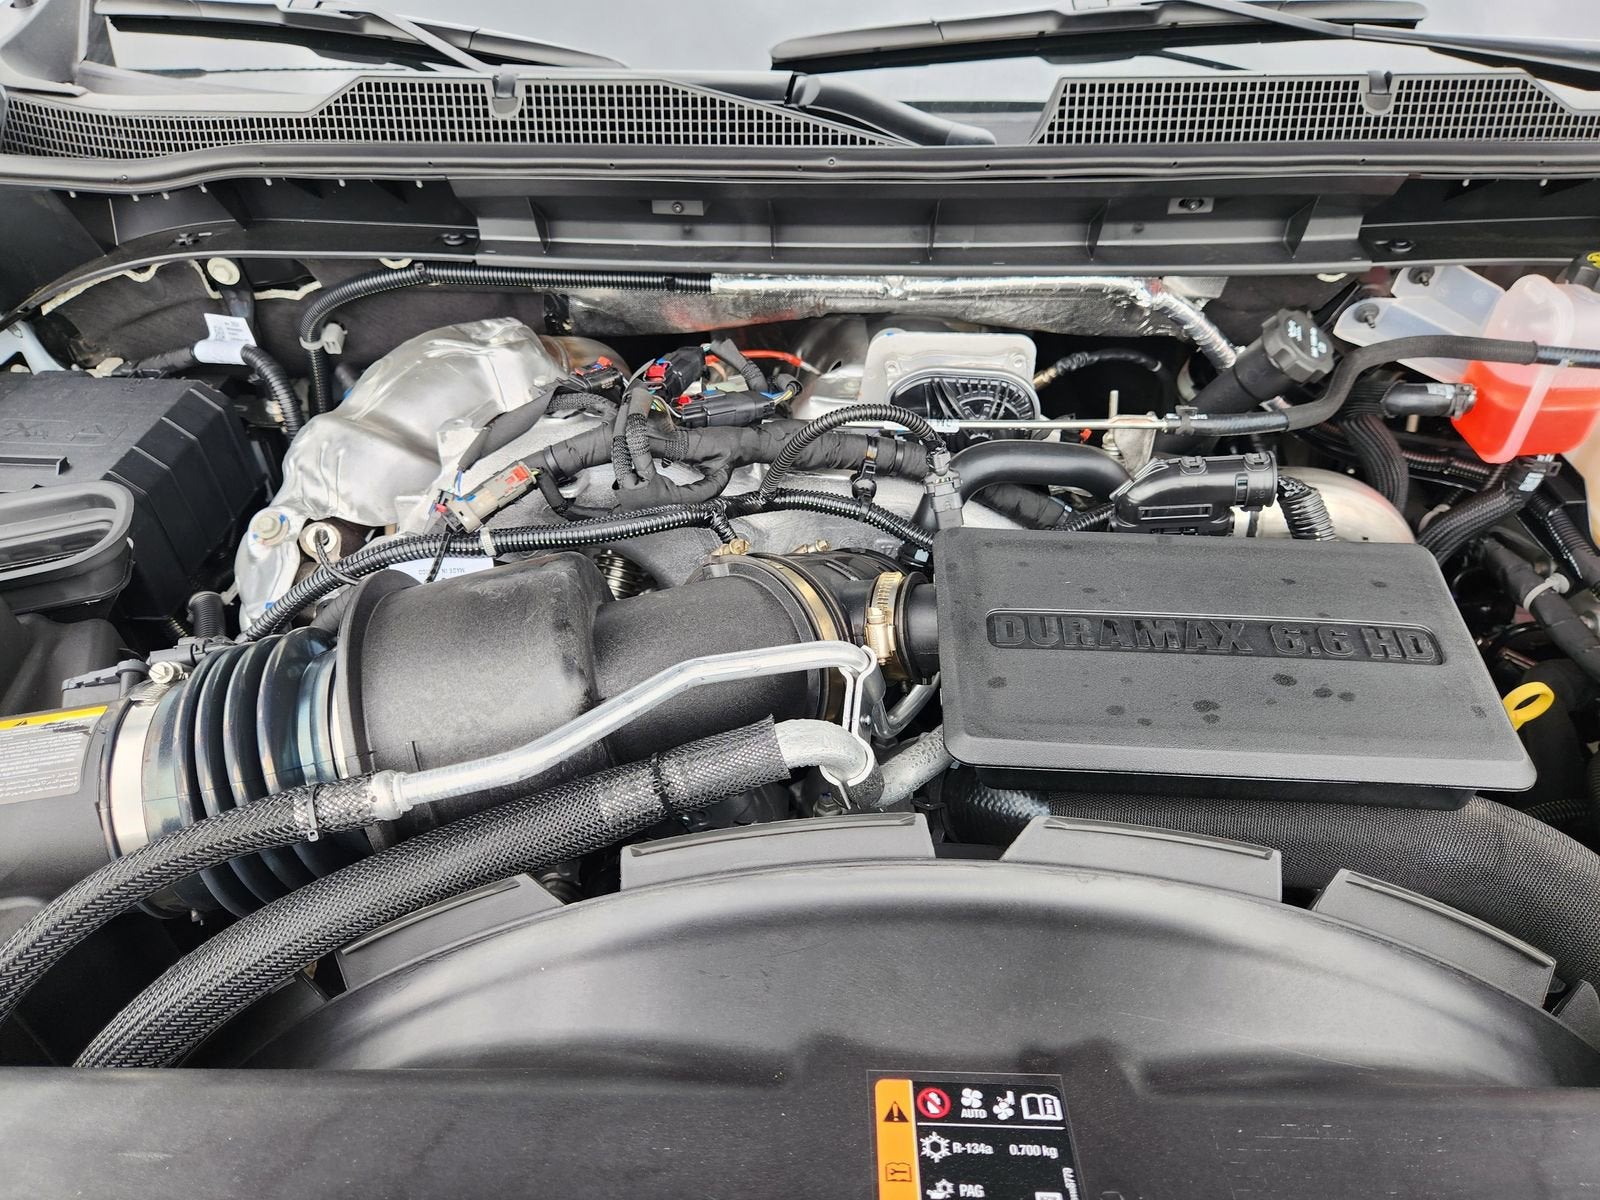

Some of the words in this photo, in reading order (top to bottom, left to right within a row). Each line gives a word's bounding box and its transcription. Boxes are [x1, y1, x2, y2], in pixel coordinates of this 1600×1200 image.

[994, 615, 1252, 652] DURAMAX
[1269, 624, 1355, 657] 6.6
[1360, 626, 1436, 662] HD
[961, 1109, 987, 1119] AUTO
[952, 1142, 994, 1155] R-134a
[1009, 1144, 1041, 1156] 0.700
[1042, 1146, 1059, 1159] kg
[959, 1184, 985, 1197] PAG
